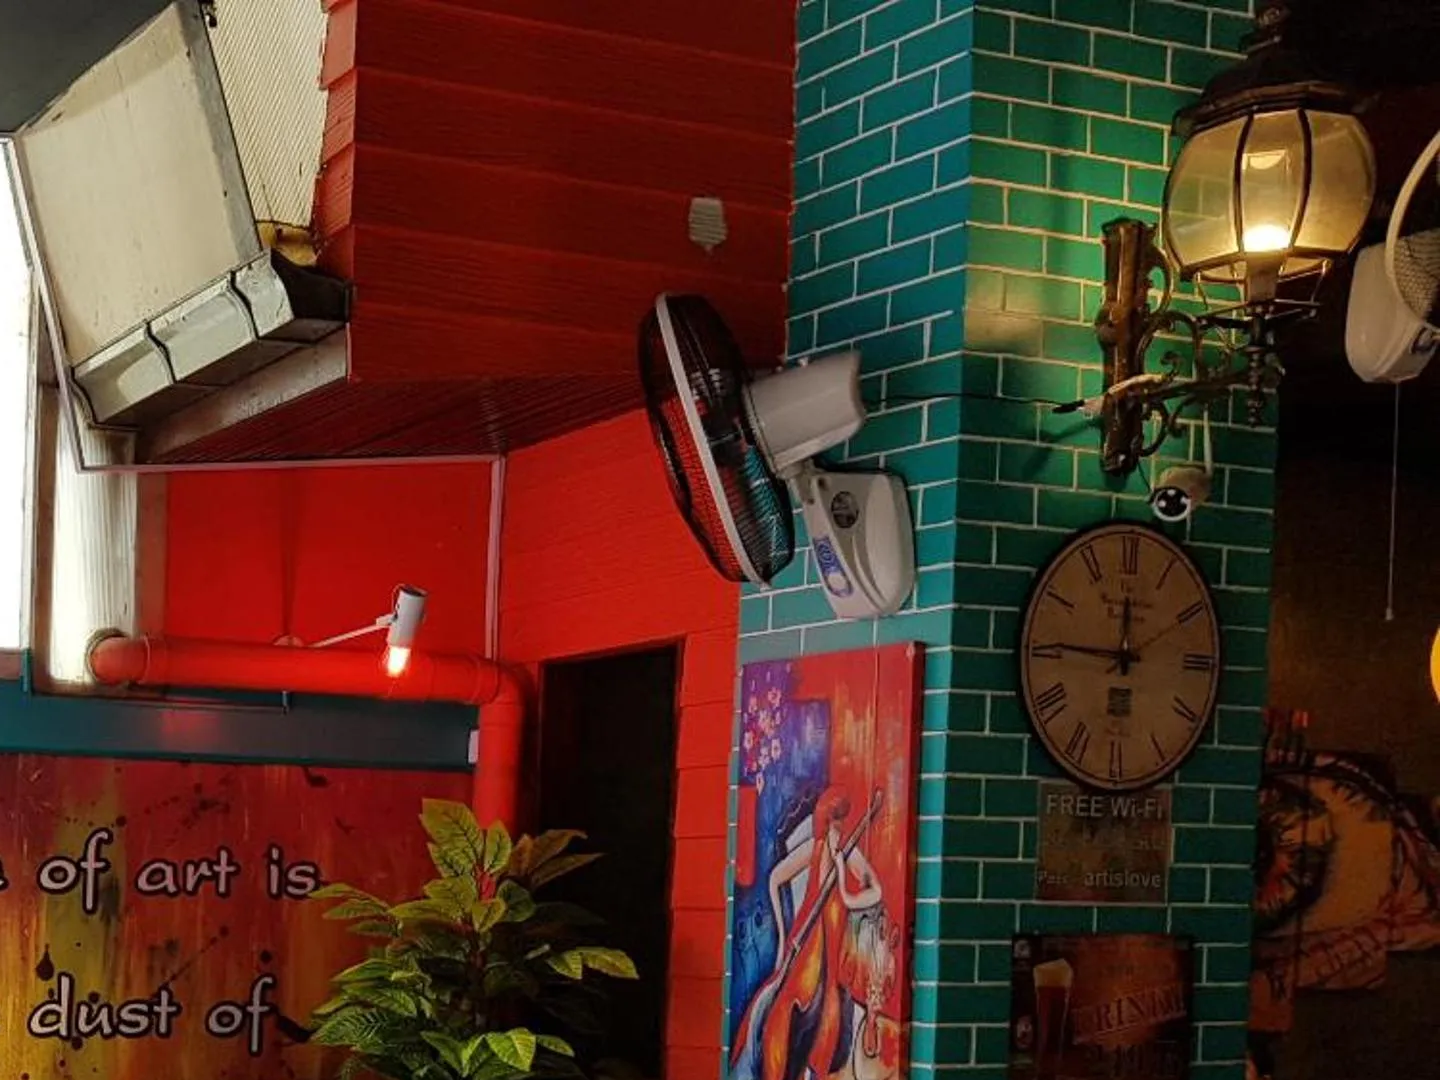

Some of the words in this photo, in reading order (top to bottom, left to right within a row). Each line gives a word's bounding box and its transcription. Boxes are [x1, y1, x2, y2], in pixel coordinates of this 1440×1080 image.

[1046, 794, 1105, 817] FREE
[1111, 795, 1163, 820] Wi-Fi
[38, 828, 112, 913] of
[137, 847, 240, 897] art
[267, 846, 320, 899] is
[28, 971, 181, 1039] dust
[206, 972, 275, 1056] of
